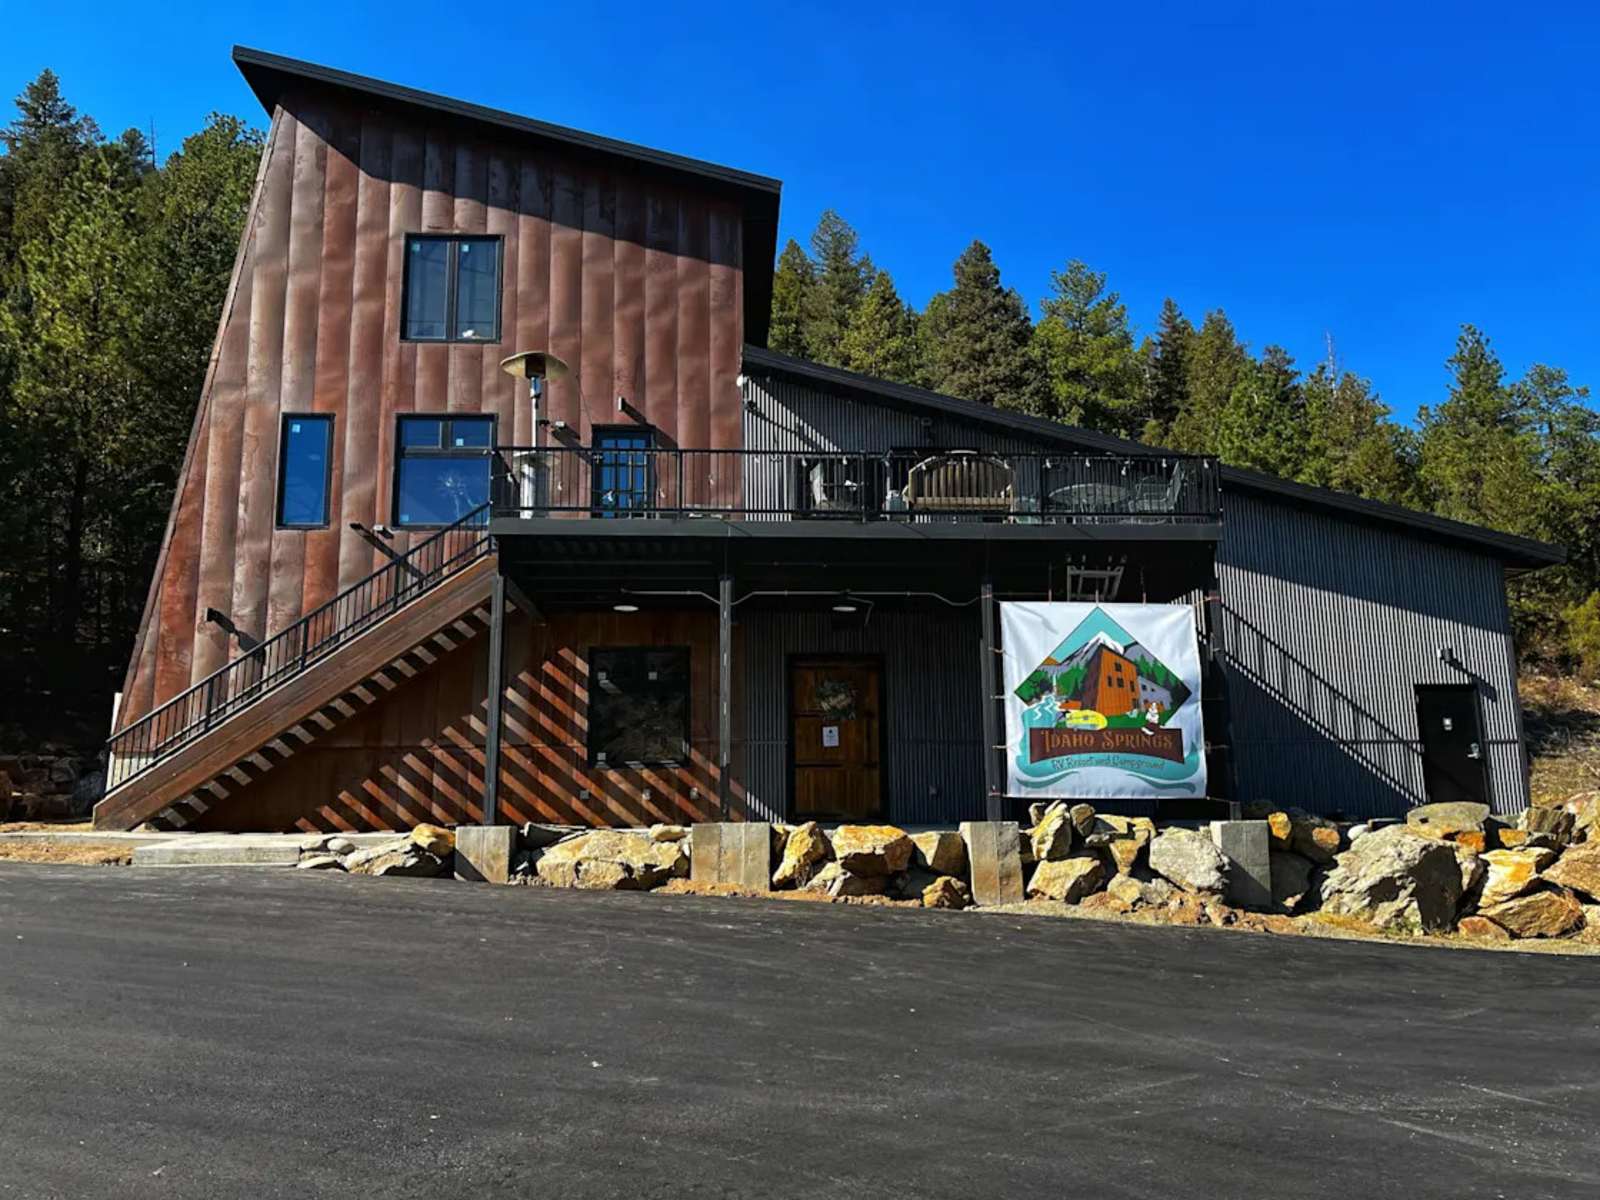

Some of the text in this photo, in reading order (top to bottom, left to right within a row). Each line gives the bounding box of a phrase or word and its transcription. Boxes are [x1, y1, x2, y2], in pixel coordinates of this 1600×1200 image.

[1041, 730, 1173, 752] IDAHO SPRINGS
[1051, 759, 1065, 770] RV
